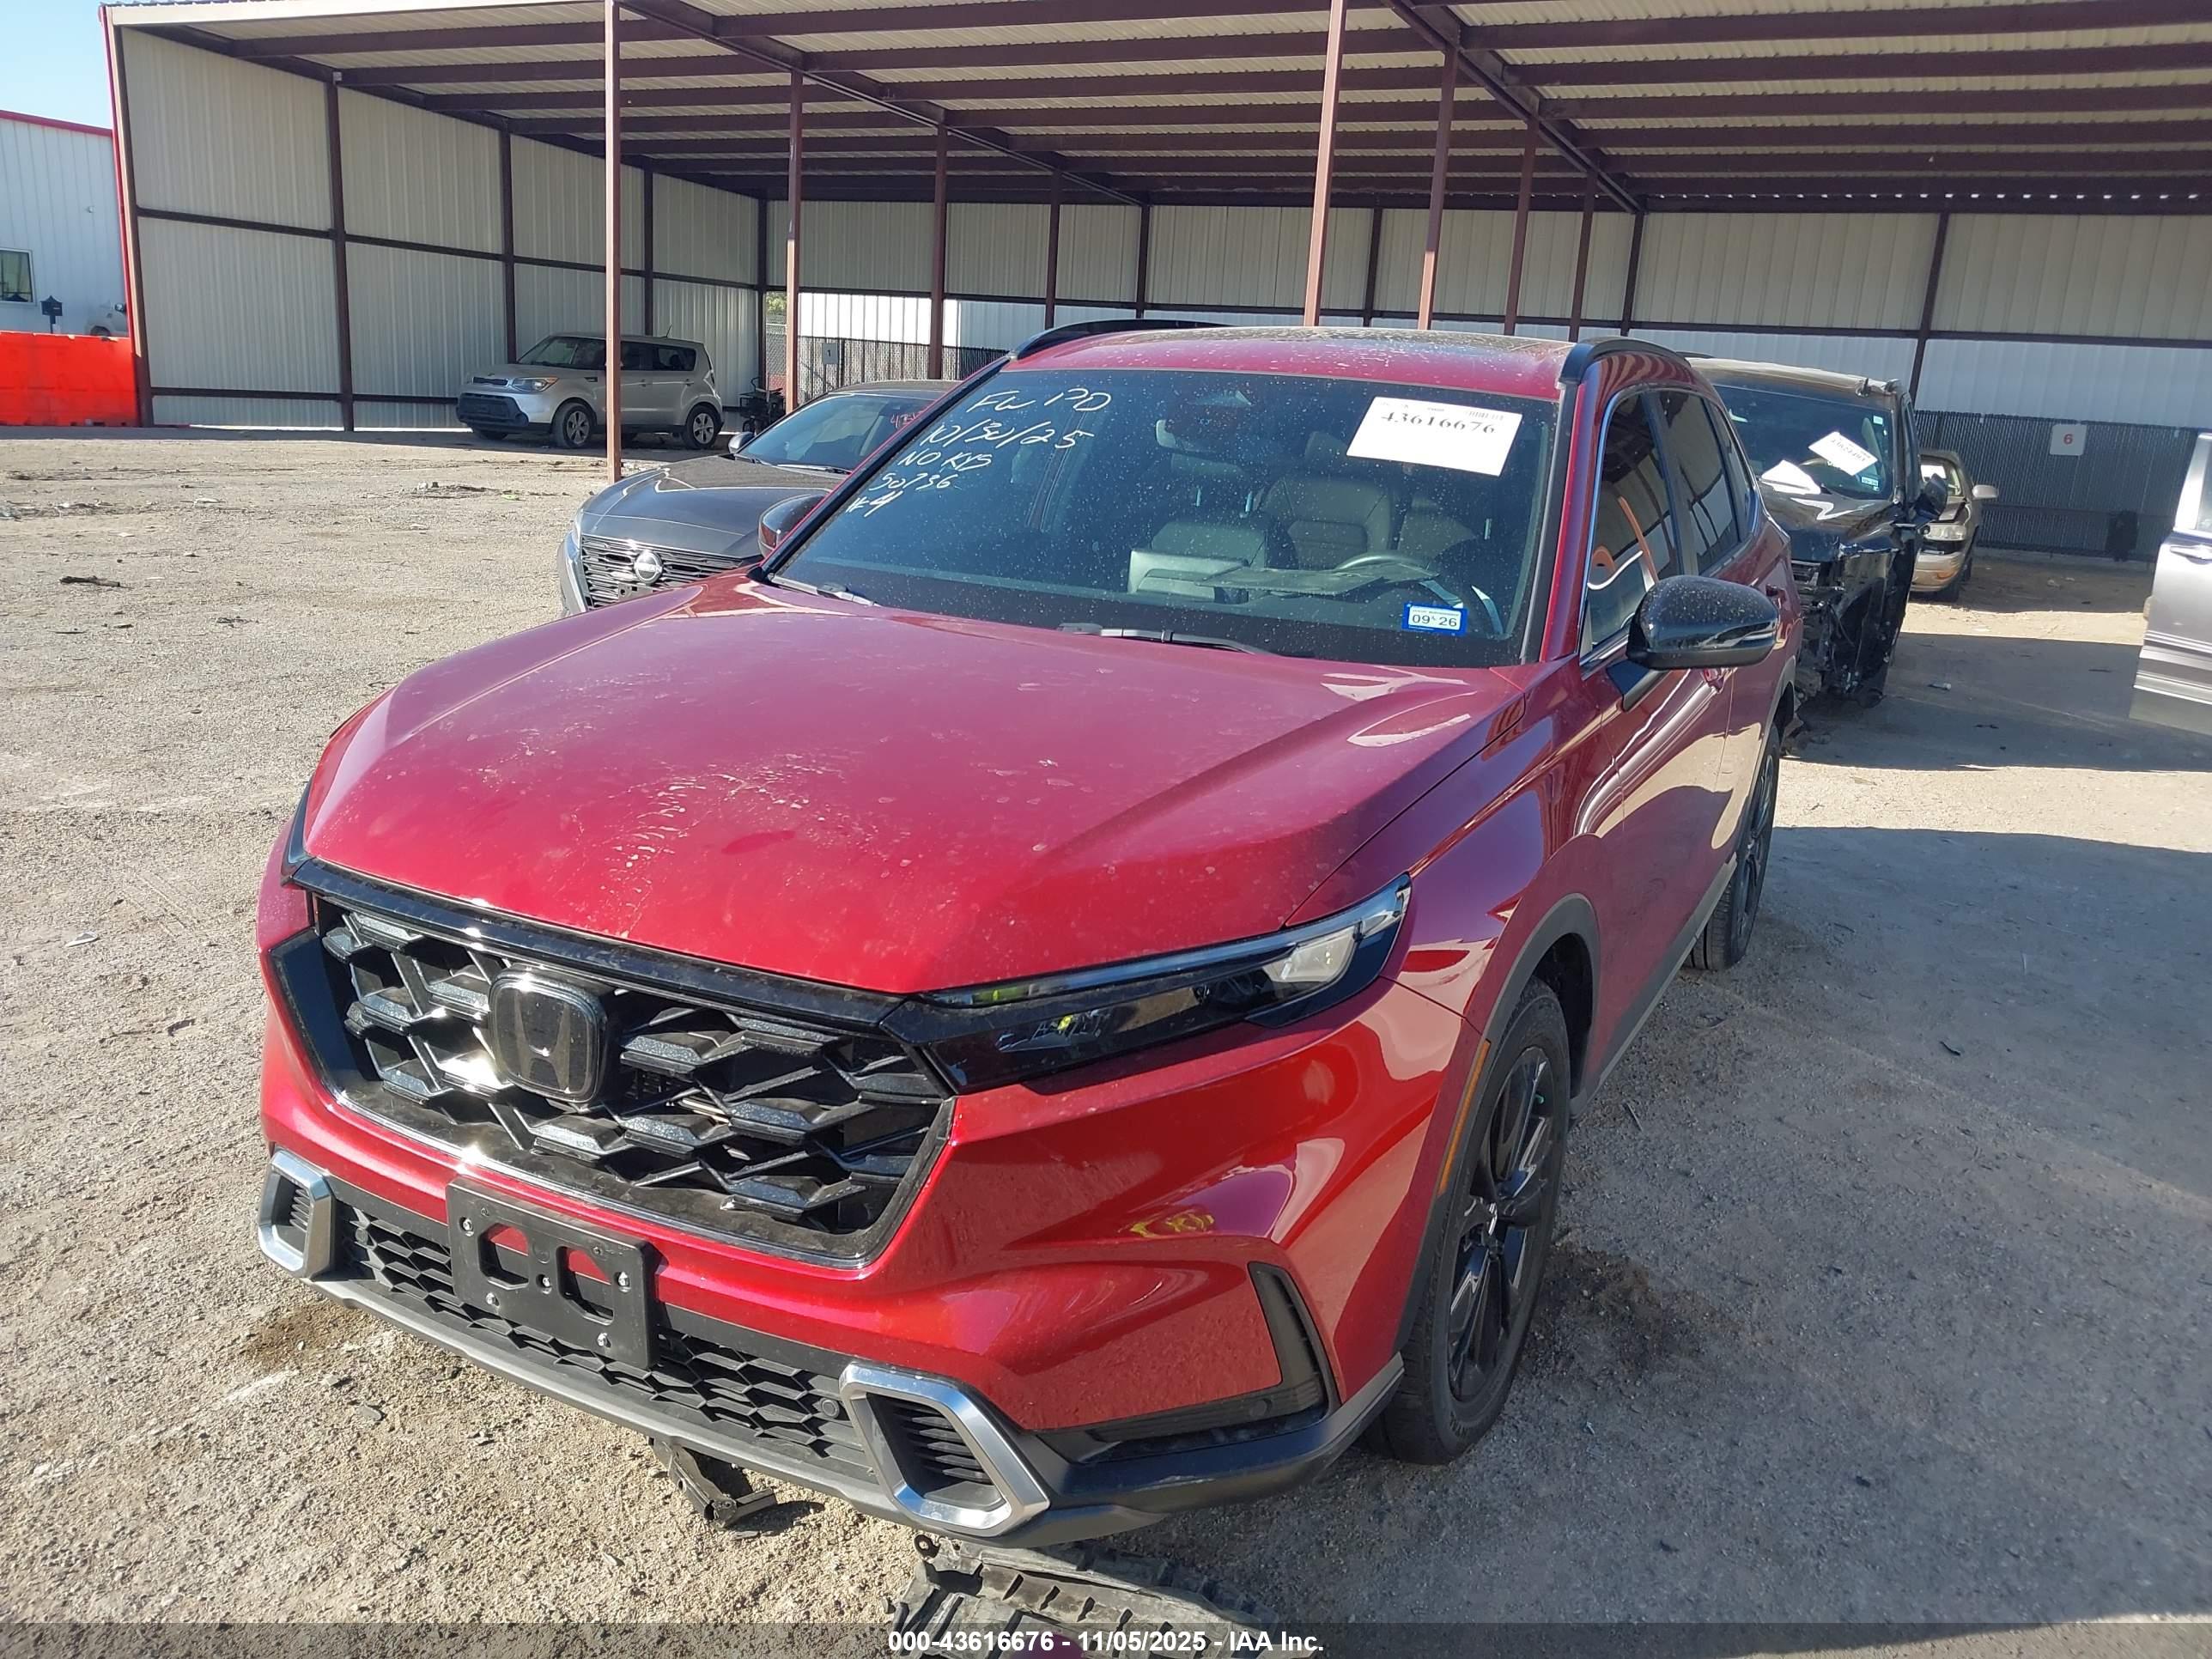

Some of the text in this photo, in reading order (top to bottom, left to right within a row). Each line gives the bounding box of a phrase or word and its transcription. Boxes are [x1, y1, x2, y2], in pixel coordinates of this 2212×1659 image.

[1043, 388, 1112, 411] PD
[1381, 411, 1496, 434] 43616676
[2063, 433, 2073, 445] 6
[897, 448, 941, 466] NO
[1412, 614, 1457, 627] 09 26
